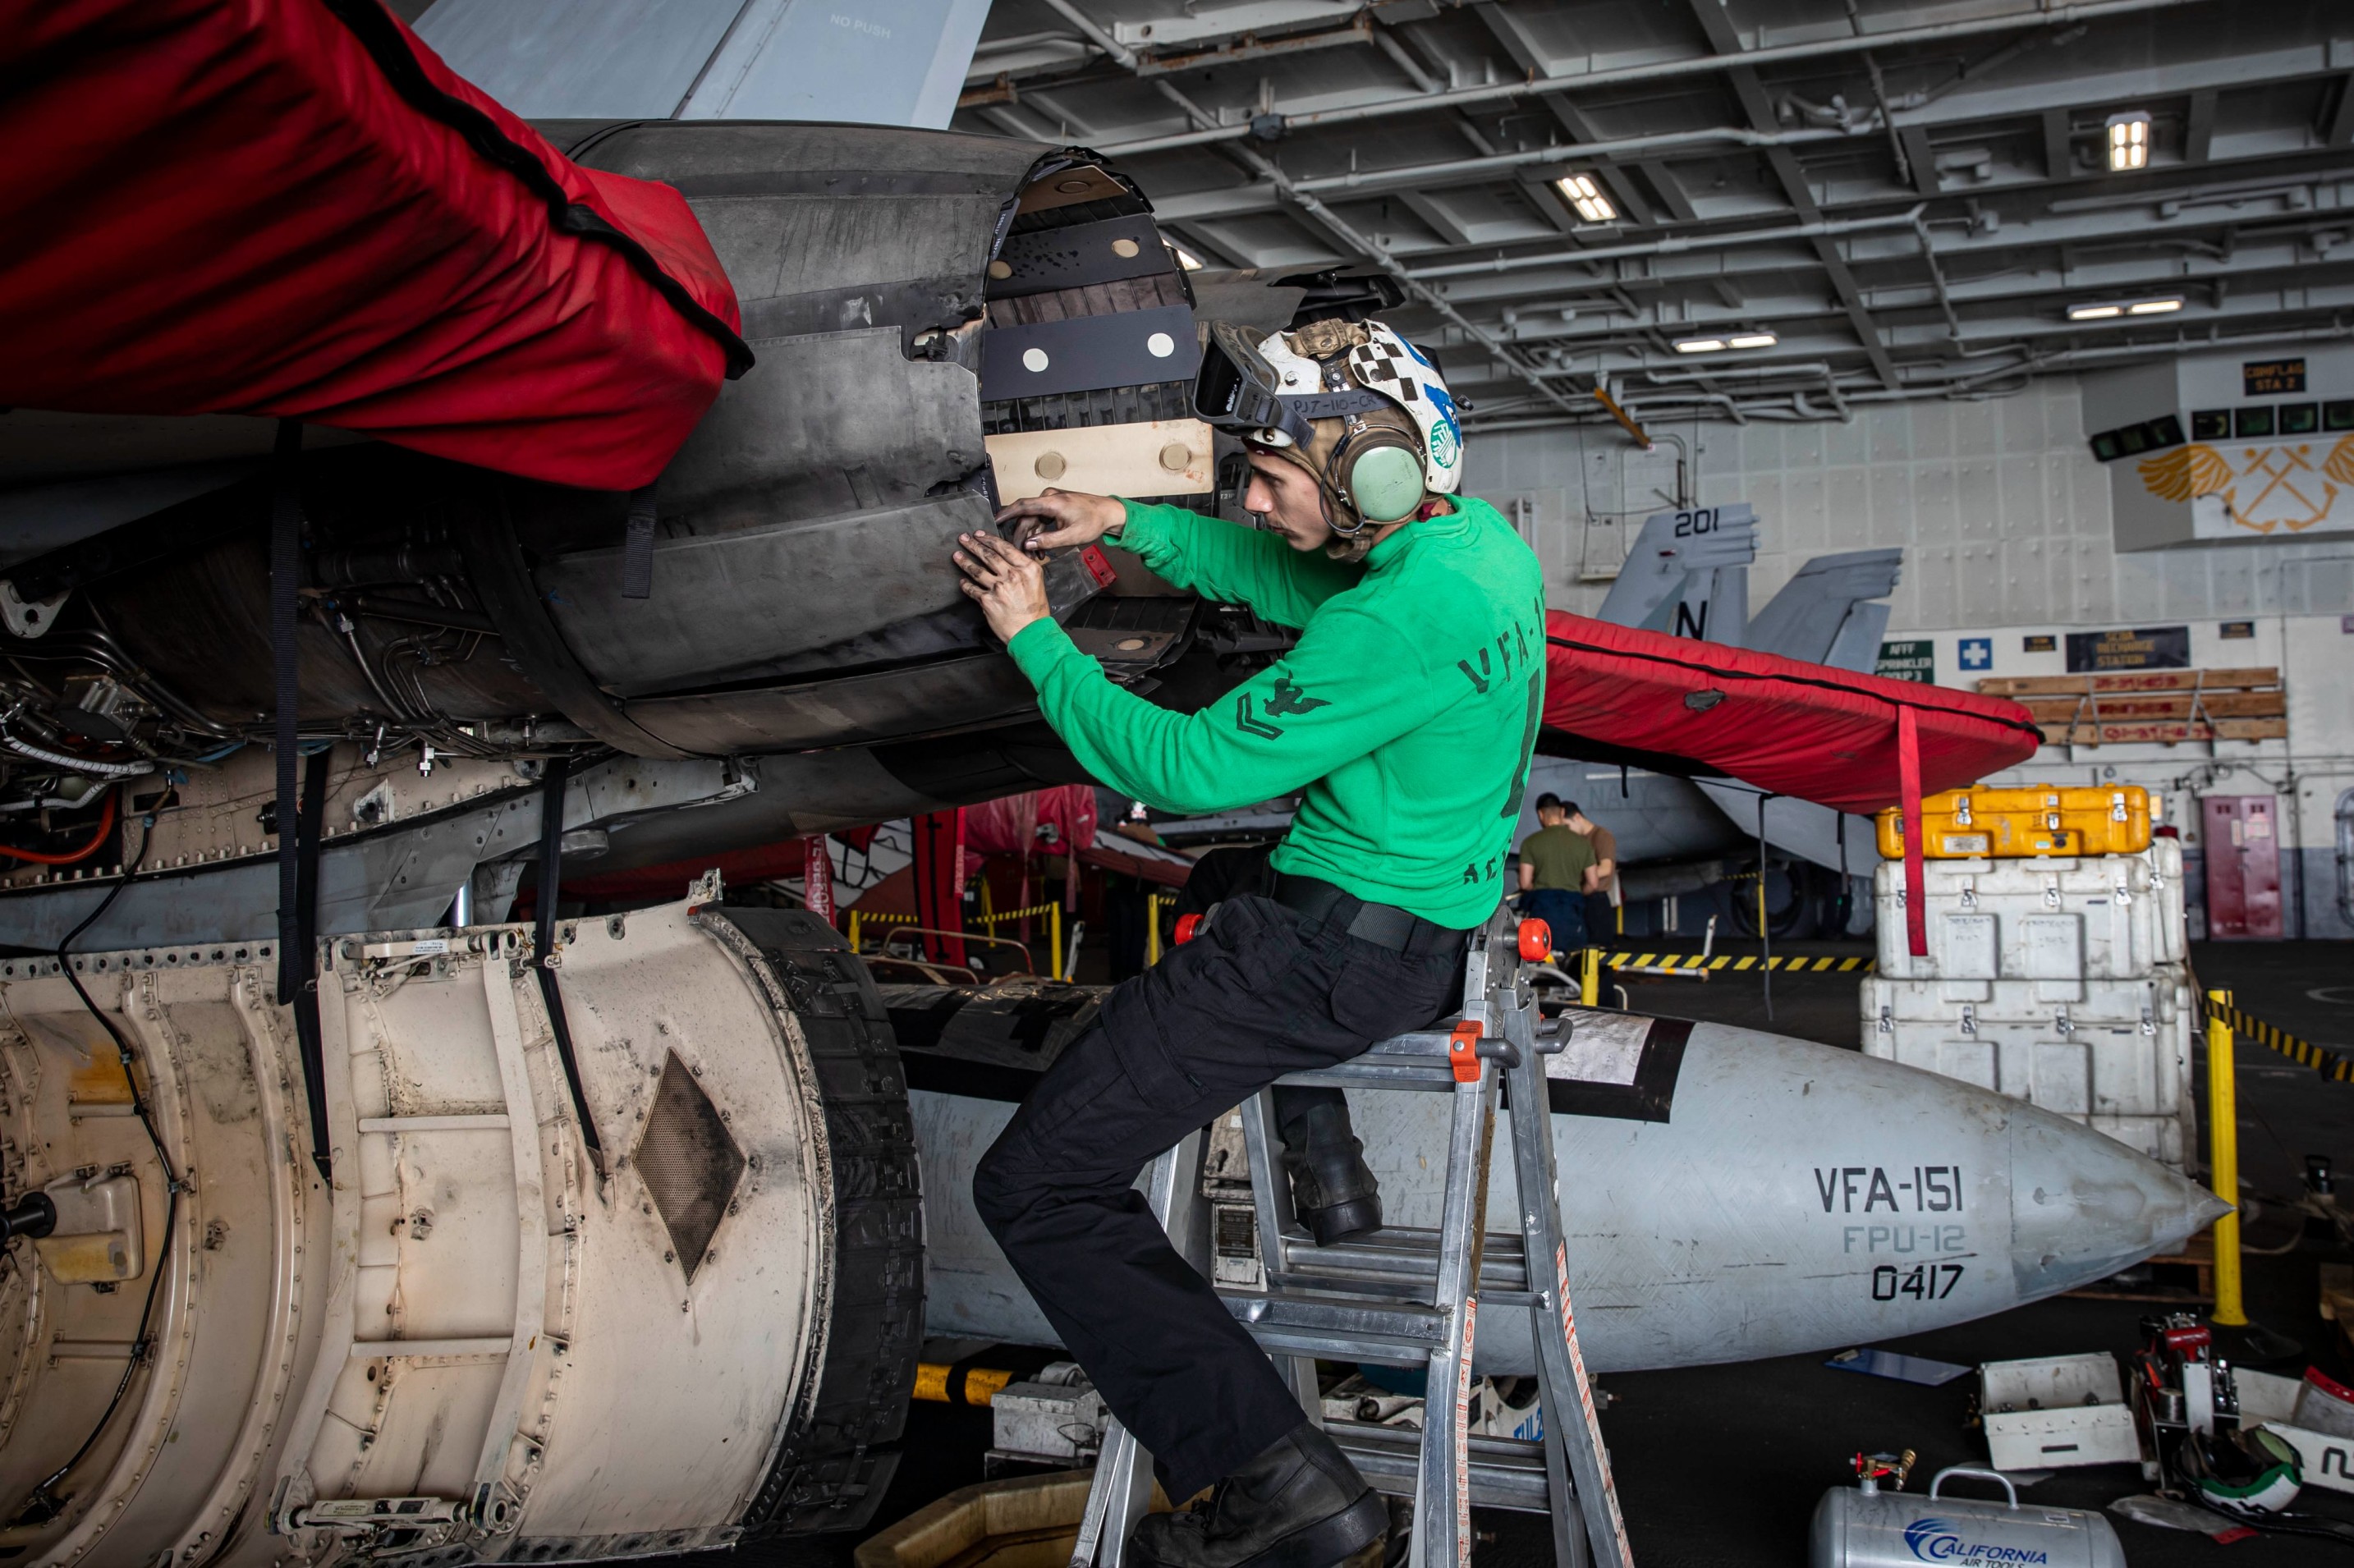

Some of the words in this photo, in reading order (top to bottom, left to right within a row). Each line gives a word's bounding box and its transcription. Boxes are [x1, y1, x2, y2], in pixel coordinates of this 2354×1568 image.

[829, 14, 851, 28] NO
[854, 20, 892, 39] PUSH
[2255, 378, 2283, 392] STA
[1675, 508, 1718, 538] 201
[1676, 600, 1708, 641] N
[1457, 582, 1545, 694] VFA-1
[1889, 643, 1916, 656] AFFF
[2097, 654, 2146, 668] STATION
[1814, 1166, 1962, 1213] VFA-151
[1843, 1224, 1966, 1254] FPU-12
[1872, 1264, 1965, 1302] 0417
[1930, 1535, 2048, 1565] CALIFORNIA
[1960, 1557, 1981, 1568] AIR
